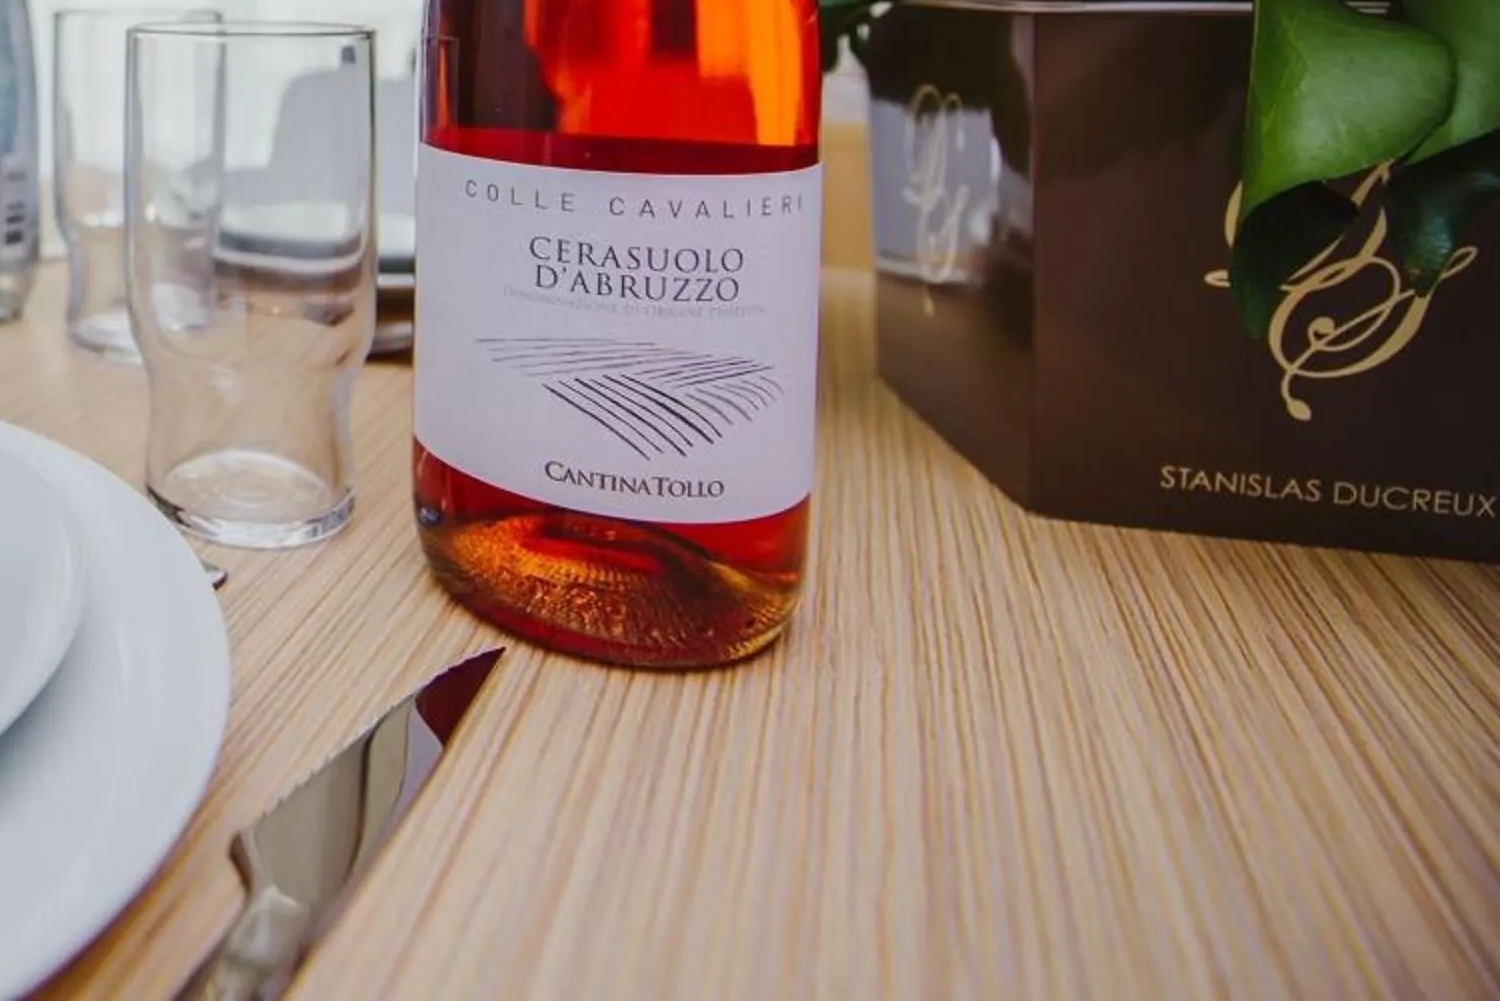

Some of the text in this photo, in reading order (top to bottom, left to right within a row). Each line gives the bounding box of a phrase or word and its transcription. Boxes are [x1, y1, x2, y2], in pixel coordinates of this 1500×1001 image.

[465, 180, 803, 218] COLLE CAVALIERI
[529, 235, 744, 273] CERASUOLO
[534, 264, 739, 302] D'ABRUZZO
[1160, 465, 1498, 518] STANISLAS DUCREUX
